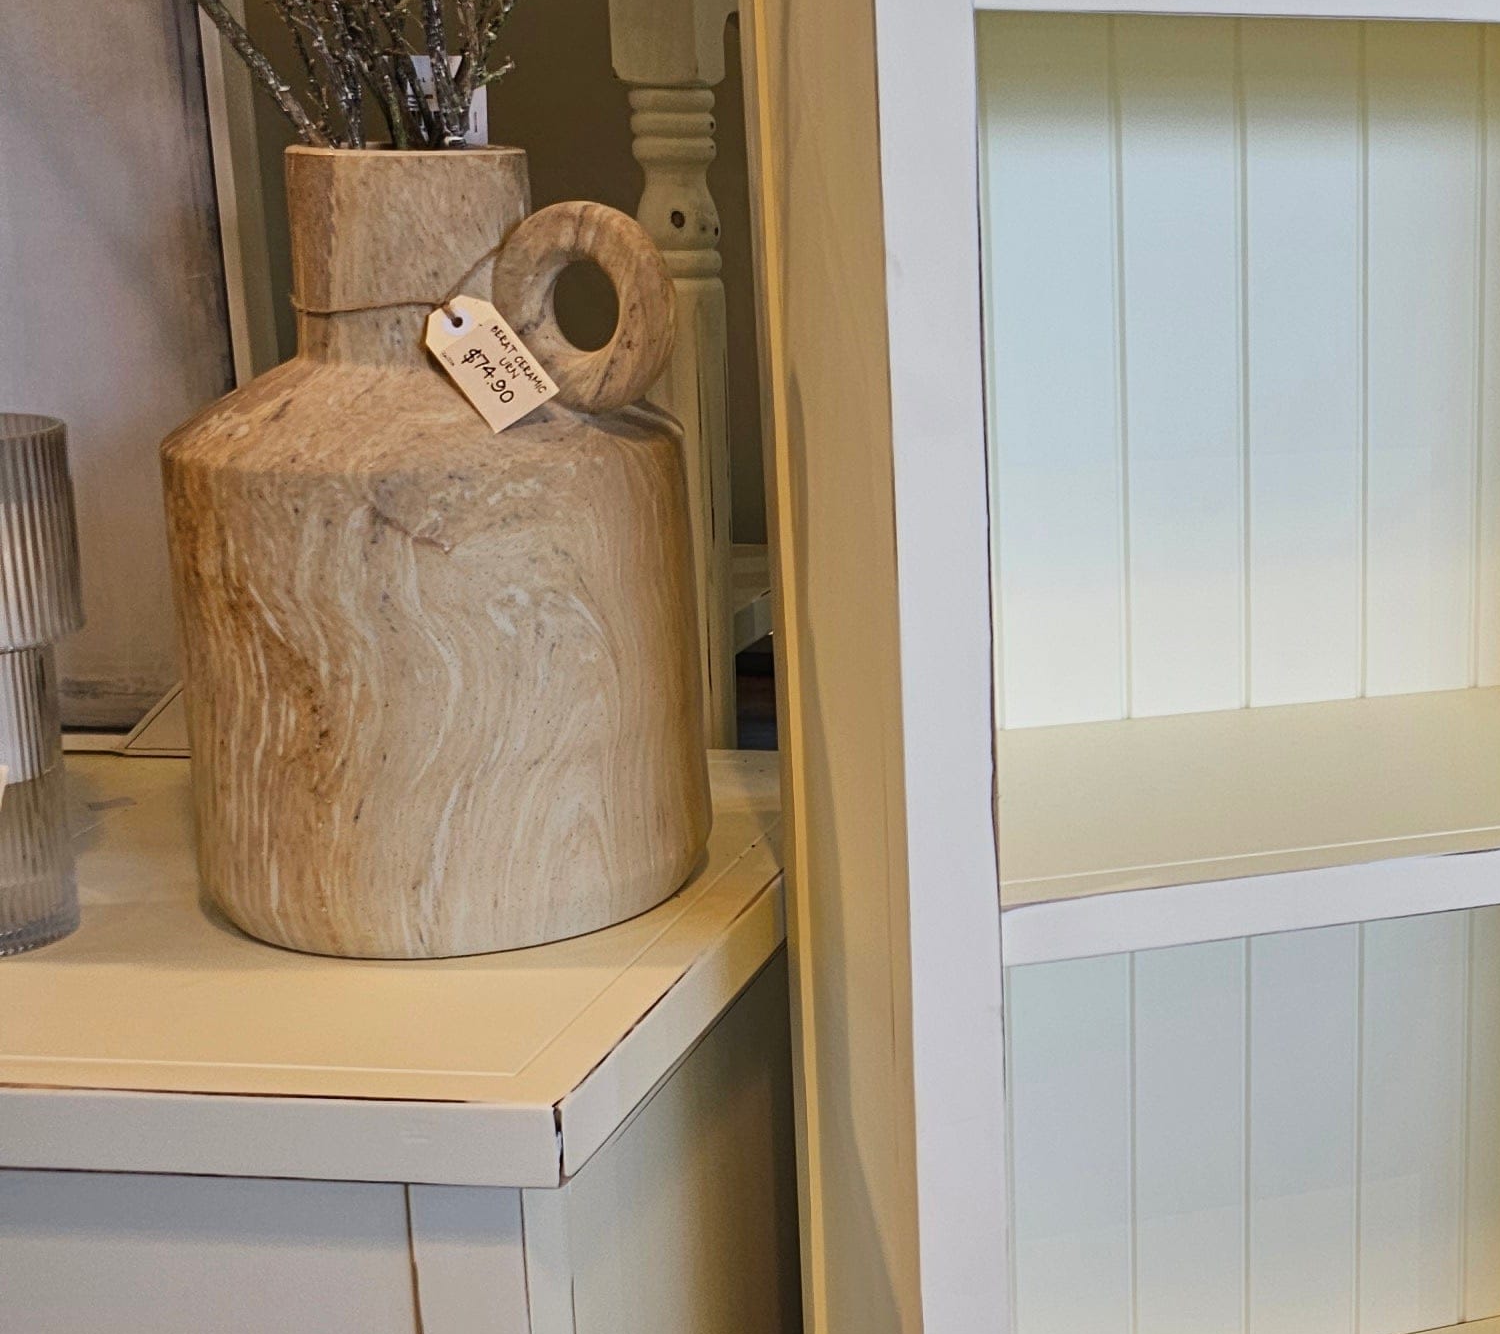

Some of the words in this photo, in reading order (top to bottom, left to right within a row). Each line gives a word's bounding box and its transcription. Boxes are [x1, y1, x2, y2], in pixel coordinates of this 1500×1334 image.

[461, 348, 514, 403] $74.90
[499, 357, 521, 380] URN
[514, 355, 548, 394] CERAMIC
